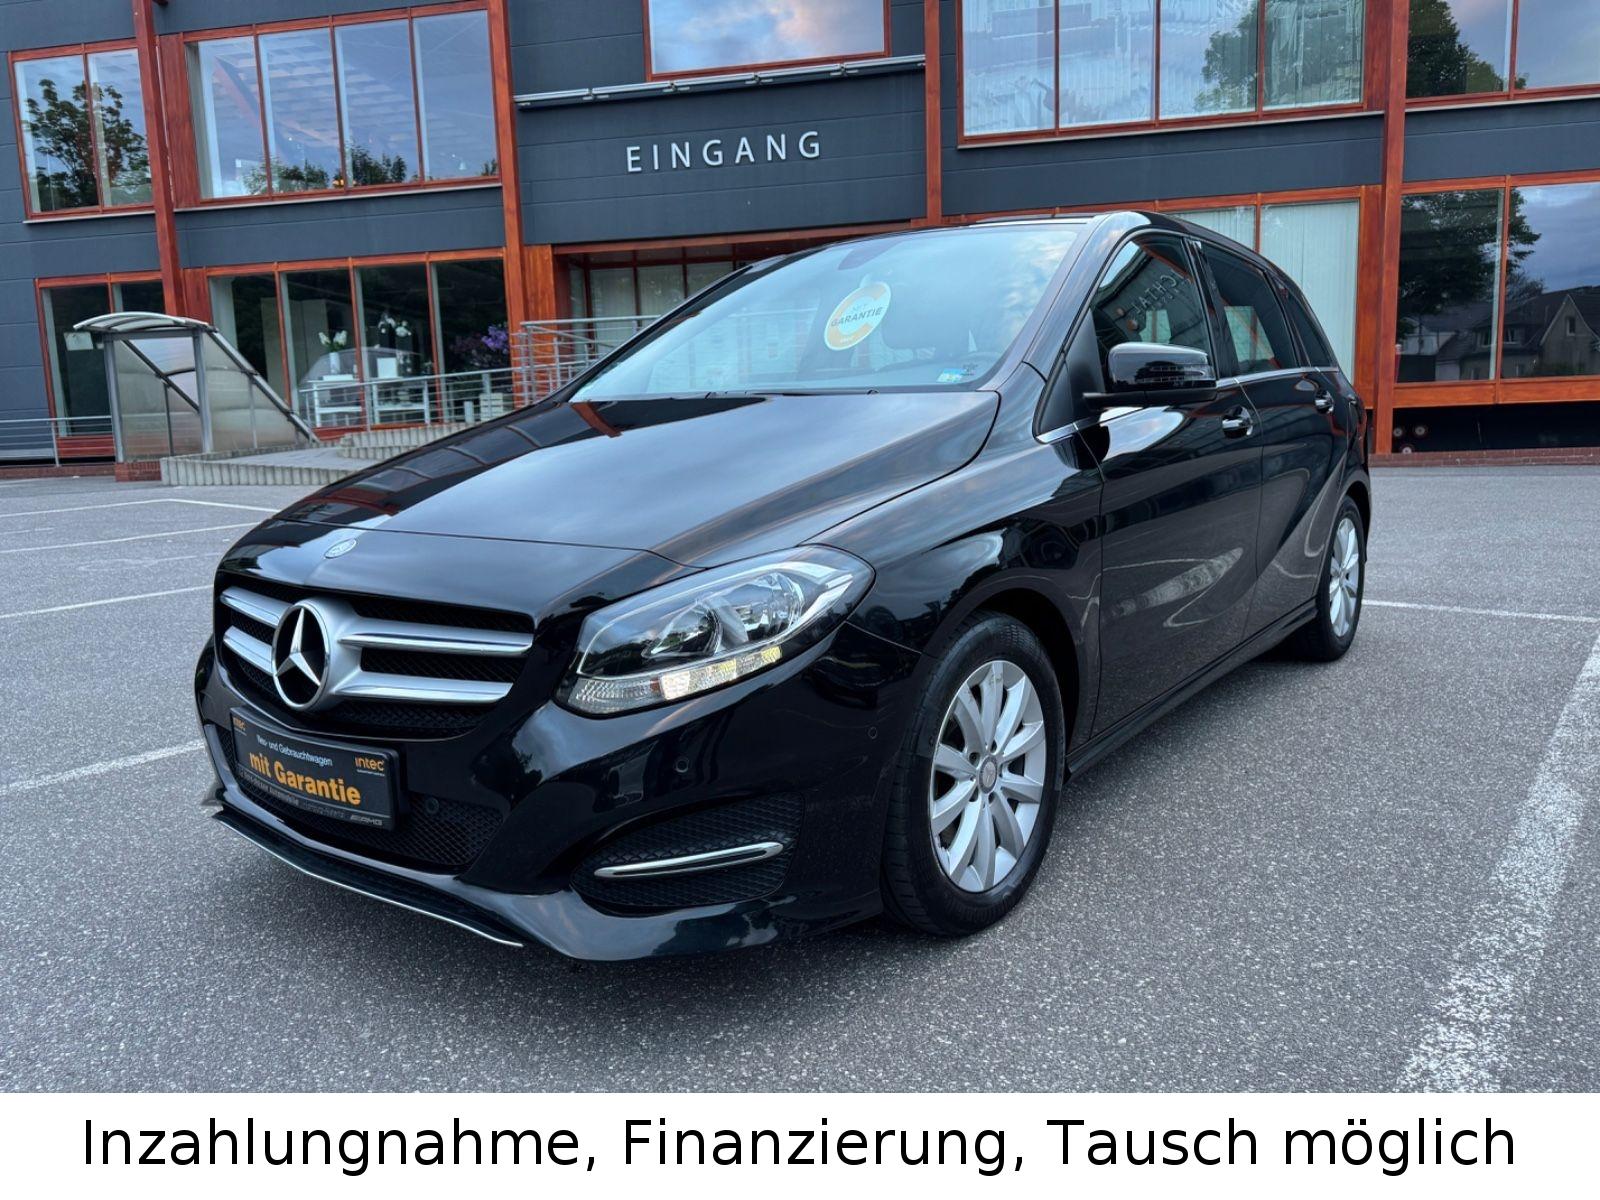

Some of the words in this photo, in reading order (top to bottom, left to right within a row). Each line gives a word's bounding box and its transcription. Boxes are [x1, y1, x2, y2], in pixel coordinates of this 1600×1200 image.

[626, 131, 820, 173] EINGANG
[830, 306, 884, 327] GARANTIE
[279, 743, 334, 767] Gebrauchtwagen
[355, 756, 385, 772] intec
[249, 752, 272, 778] mit
[273, 761, 361, 806] Garantie
